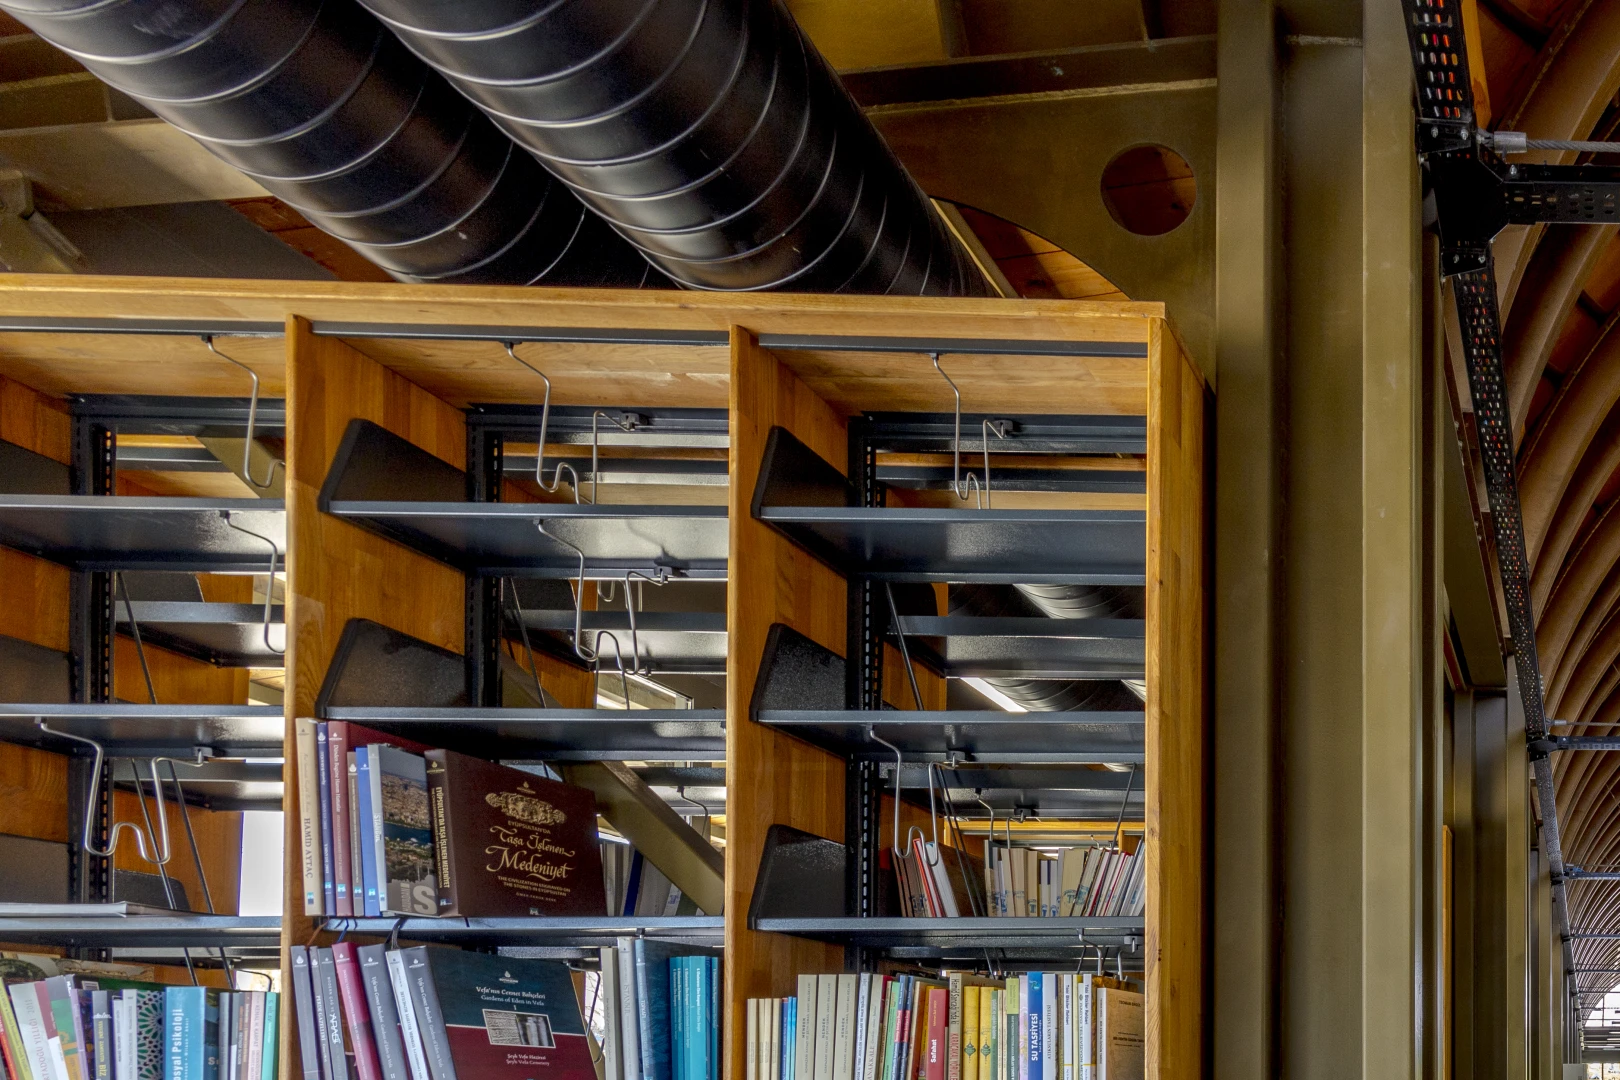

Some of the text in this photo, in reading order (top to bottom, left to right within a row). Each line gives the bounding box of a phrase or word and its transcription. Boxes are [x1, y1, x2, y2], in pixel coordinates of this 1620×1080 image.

[304, 818, 312, 847] HAMİD
[436, 786, 450, 889] EYÜPSULTAN'DA TAŞA İŞLENEN MEDENİYET
[490, 825, 575, 857] Taşa İşlenen
[305, 850, 314, 878] AYTAÇ
[485, 845, 576, 882] Medeniyet
[476, 986, 500, 995] Vefa'nın
[950, 978, 959, 992] Hamid
[24, 999, 34, 1014] 2011
[29, 1017, 41, 1044] YILLIĞI
[172, 1009, 184, 1053] Psikoloji
[1028, 1013, 1038, 1060] SU TASFİYESİ
[98, 1064, 107, 1076] BİZ
